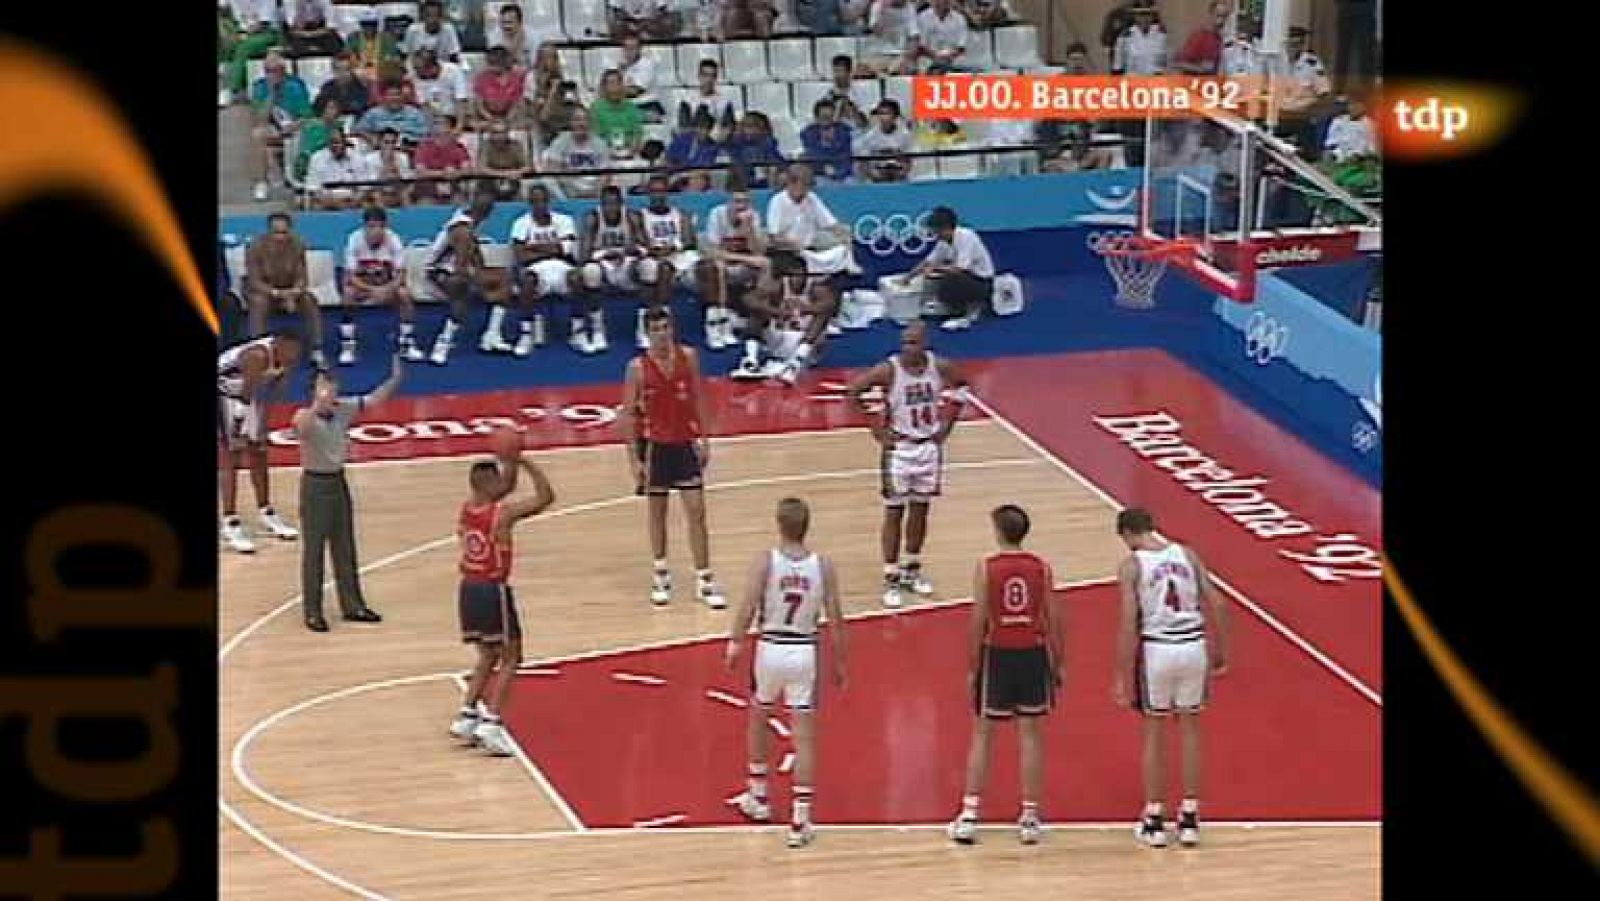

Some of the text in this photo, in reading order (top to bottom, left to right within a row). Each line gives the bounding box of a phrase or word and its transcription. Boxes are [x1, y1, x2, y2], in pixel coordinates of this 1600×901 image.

[911, 406, 934, 428] 14
[1091, 410, 1383, 583] Barcelona '92
[783, 592, 803, 626] 7
[1004, 577, 1028, 611] 8
[1164, 578, 1181, 613] 4
